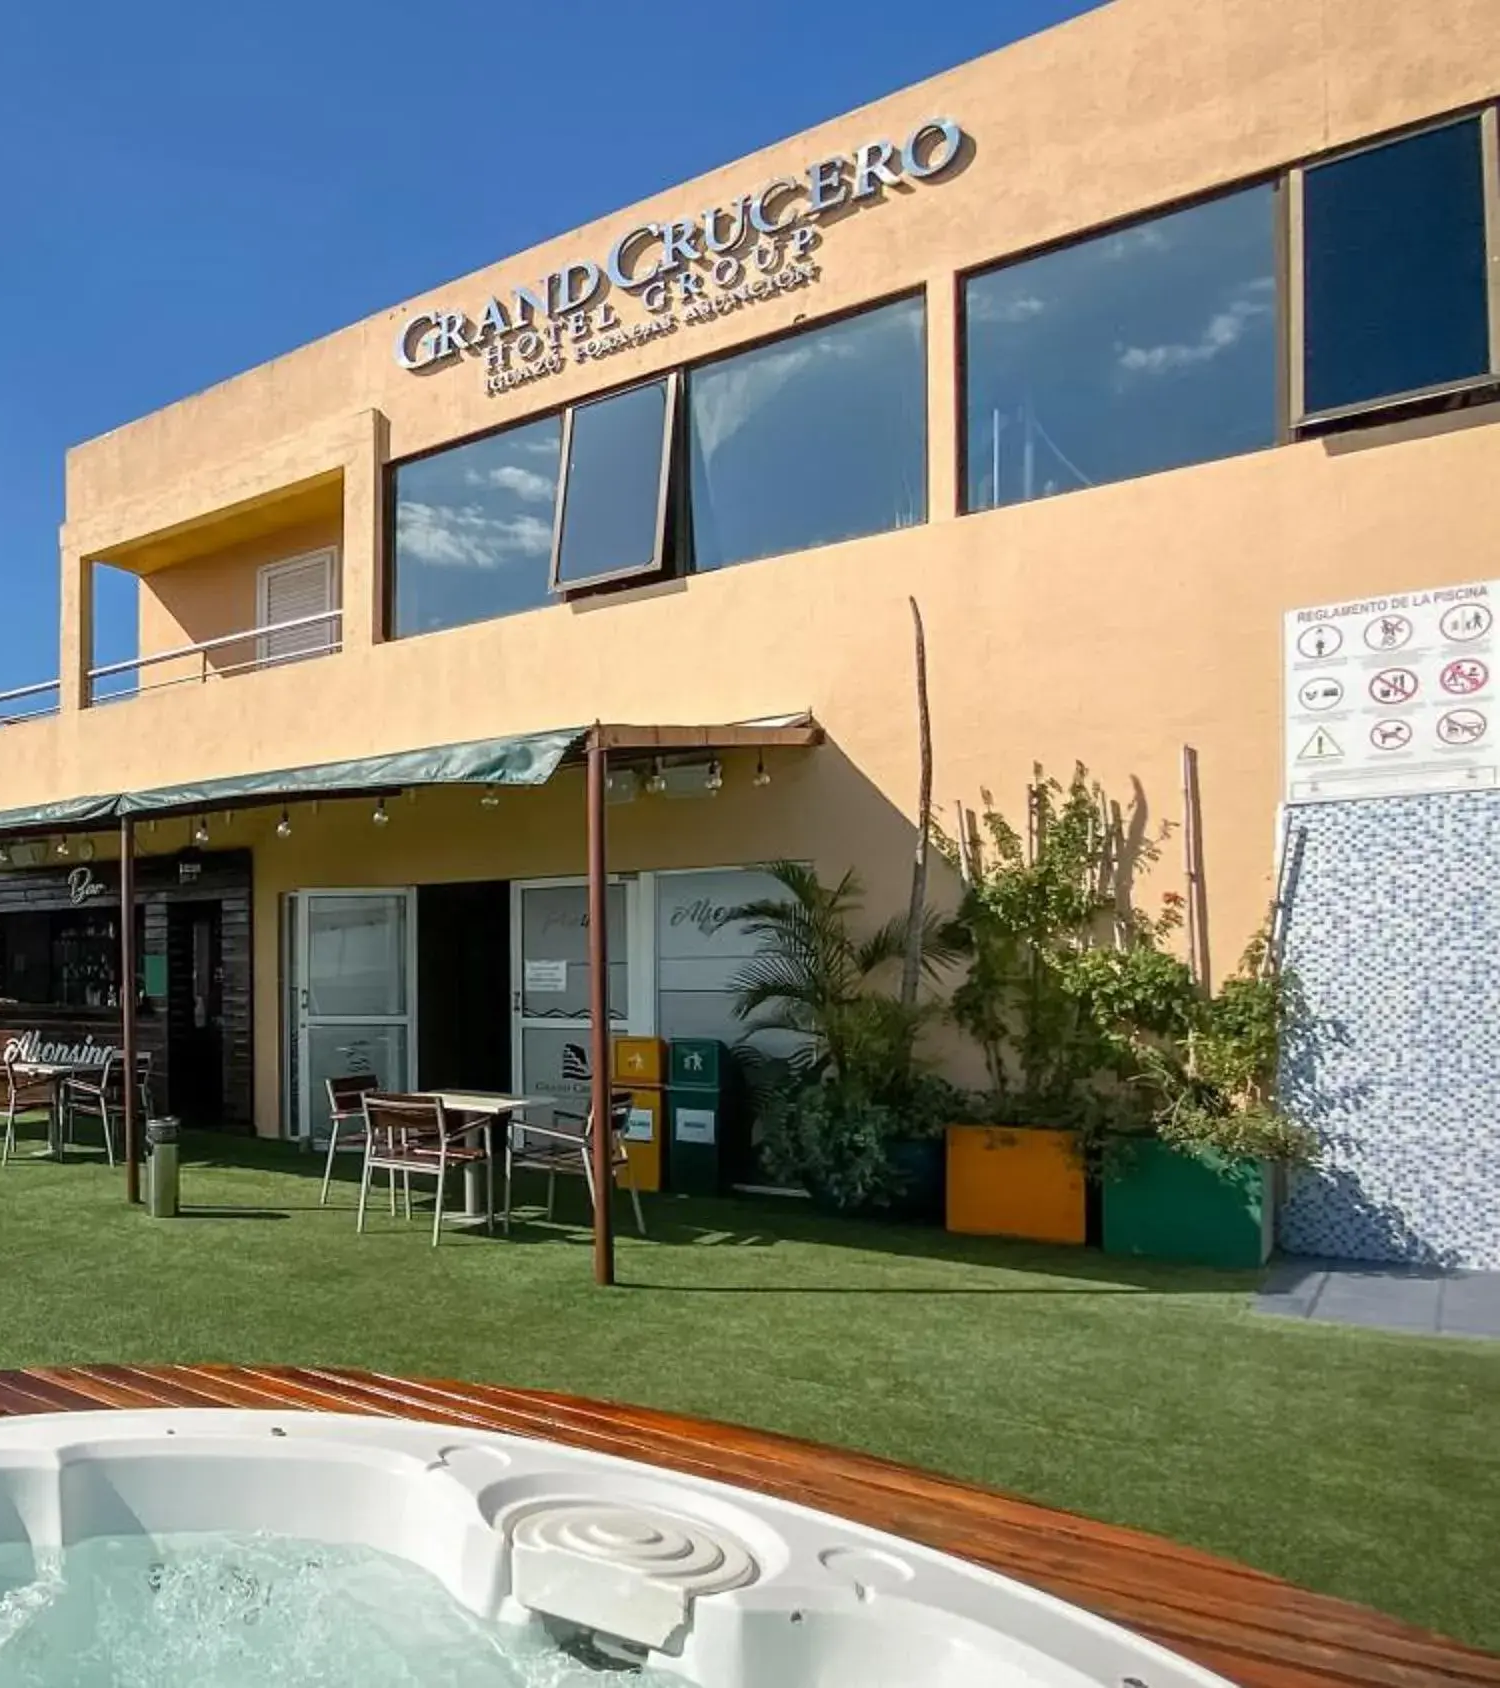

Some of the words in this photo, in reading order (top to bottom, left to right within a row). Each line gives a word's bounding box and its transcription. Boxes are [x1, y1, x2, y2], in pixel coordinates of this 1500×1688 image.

[394, 262, 601, 370] GRAND
[607, 117, 962, 288] CRUCERO
[485, 303, 617, 369] HOTEL
[642, 224, 817, 312] GROUP
[1297, 601, 1388, 622] REGLAMENTO
[1391, 597, 1410, 608] DE
[1412, 595, 1432, 607] LA
[1433, 586, 1488, 603] PISCINA
[68, 867, 106, 905] Bar
